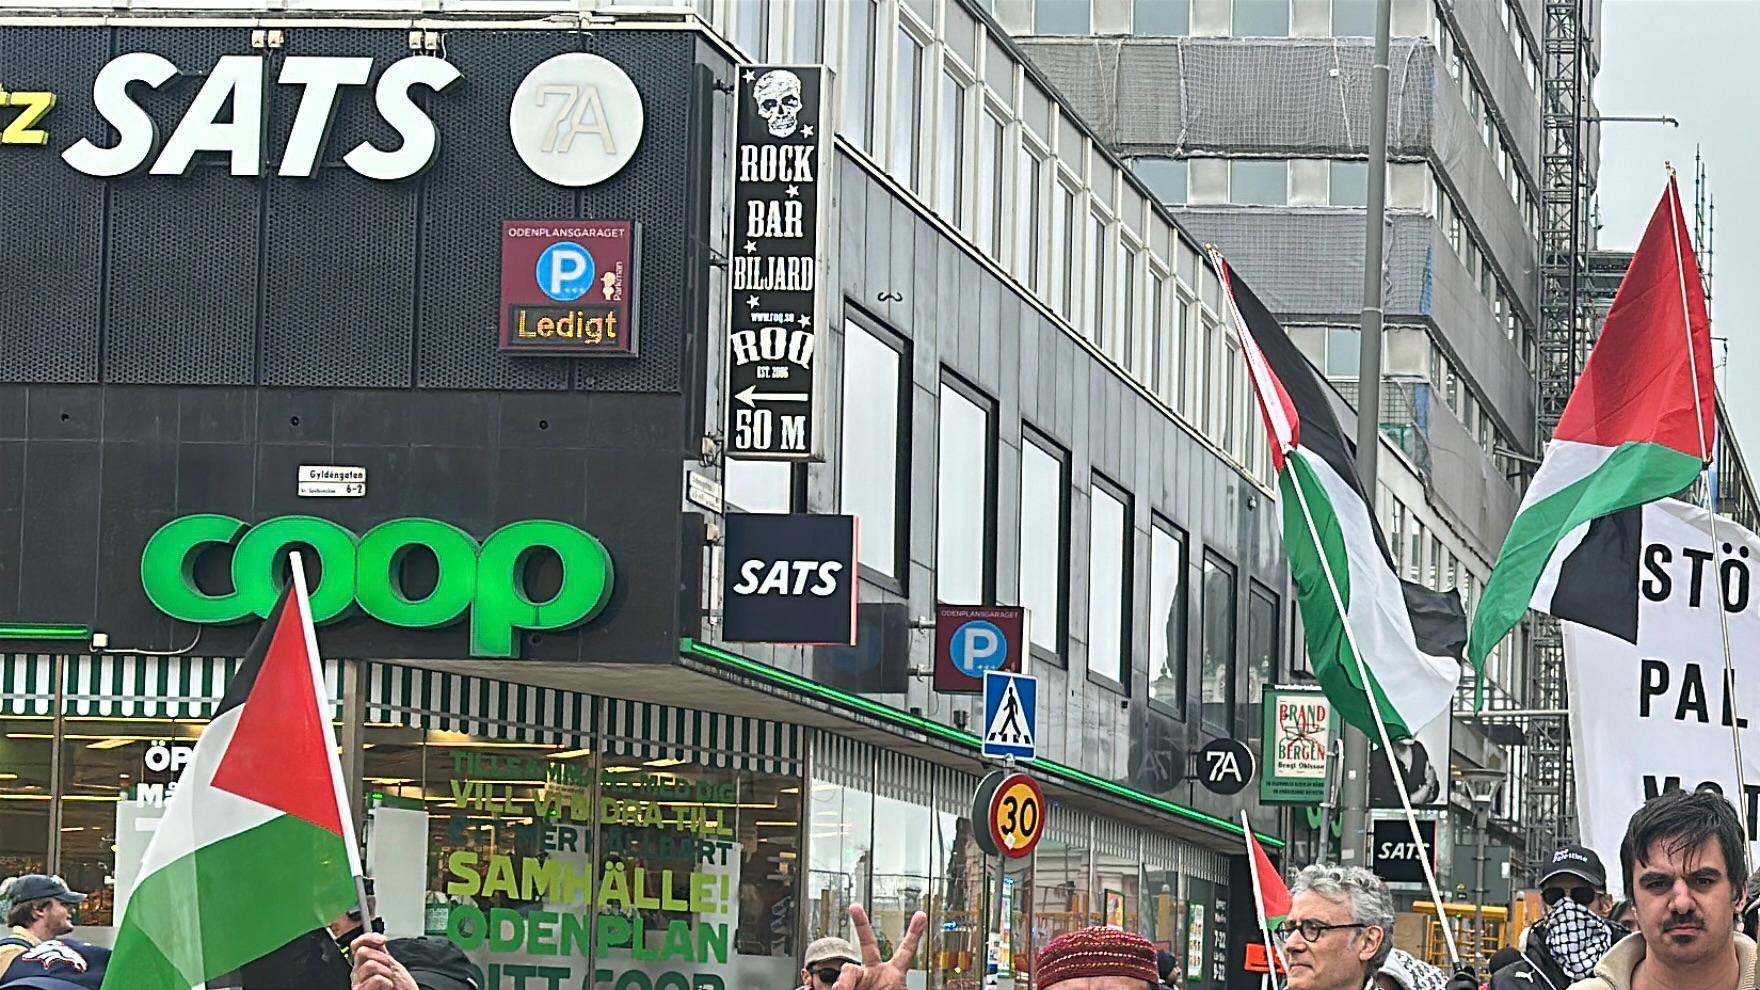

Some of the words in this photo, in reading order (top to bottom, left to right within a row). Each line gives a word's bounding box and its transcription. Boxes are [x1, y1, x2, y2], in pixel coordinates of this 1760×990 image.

[61, 52, 464, 180] SATS
[535, 84, 617, 154] 7A
[740, 144, 815, 182] ROCK
[508, 227, 625, 238] ODENPLANSGARAGET
[747, 200, 804, 238] BAR
[551, 250, 587, 294] P
[613, 261, 623, 301] Parkman
[733, 256, 814, 291] BILJARD
[518, 310, 617, 344] Ledigt
[731, 326, 815, 370] ROQ
[735, 409, 772, 450] 50
[780, 415, 806, 450] M
[141, 513, 614, 657] coop
[733, 559, 843, 596] SATS
[964, 627, 999, 671] P
[1280, 704, 1326, 721] BRAND
[1206, 751, 1243, 783] 7A
[1279, 744, 1325, 761] BERGEN
[450, 779, 524, 815] VILL
[570, 790, 665, 830] BDRA
[672, 805, 734, 836] TILL
[1001, 796, 1037, 837] 30
[447, 850, 730, 915] SAMHÄLLE!
[447, 904, 728, 964] ODENPLAN
